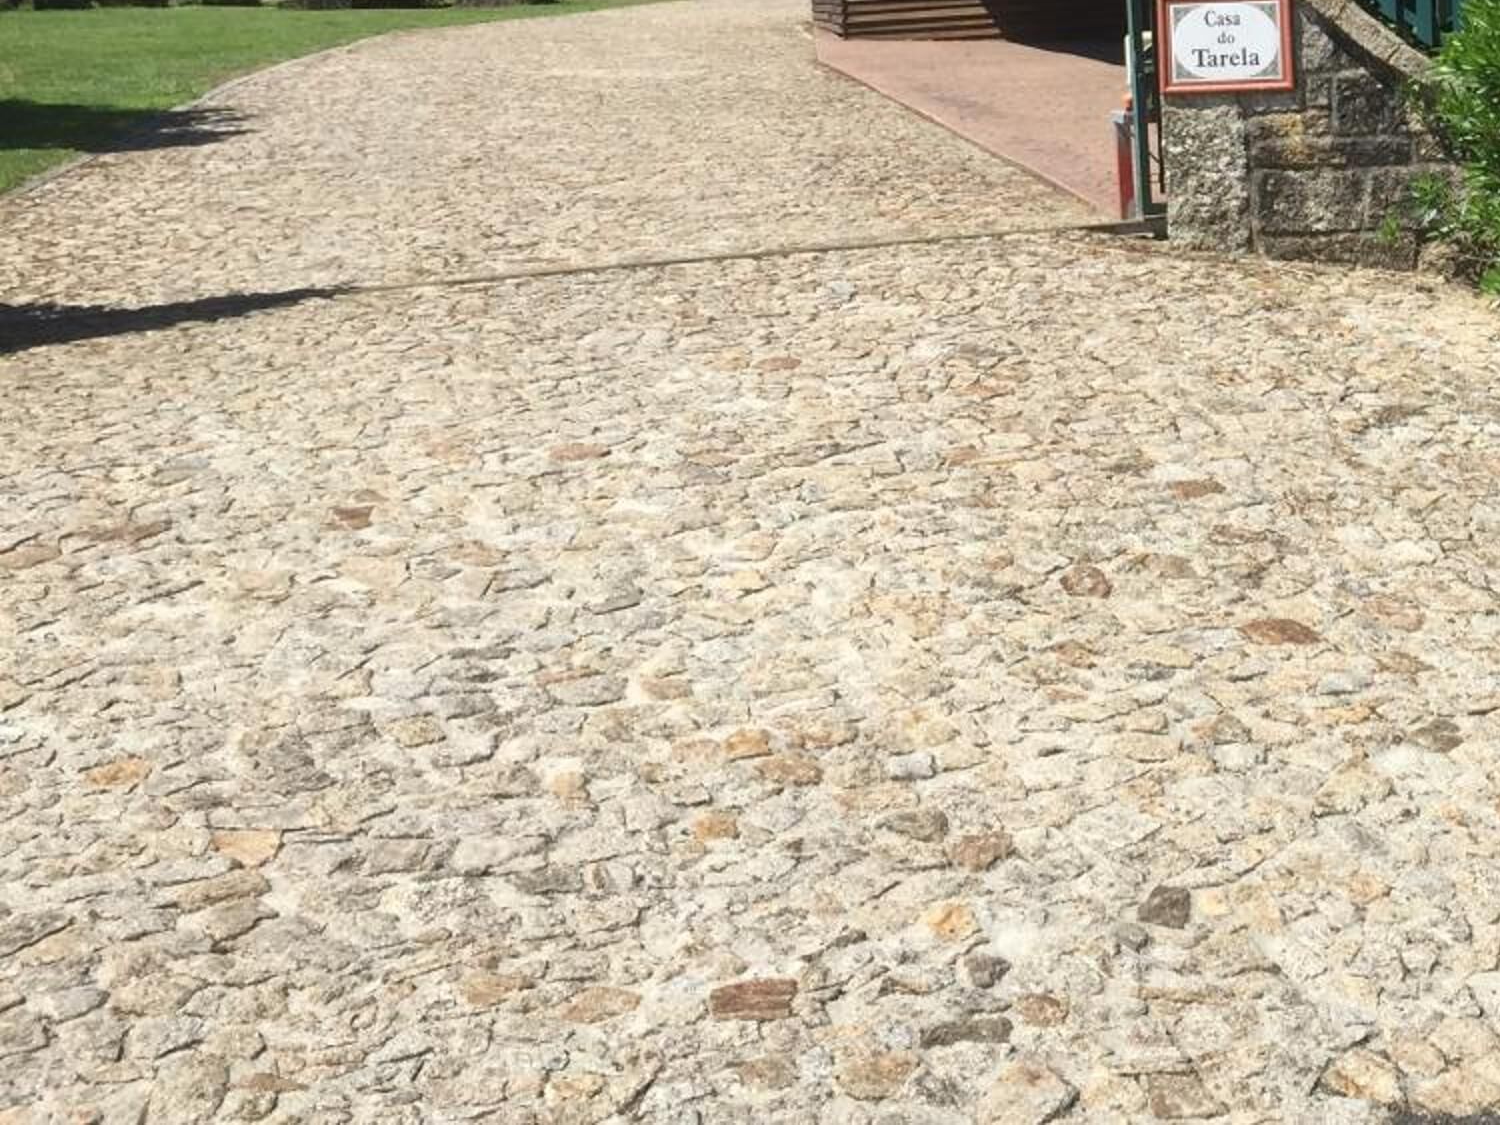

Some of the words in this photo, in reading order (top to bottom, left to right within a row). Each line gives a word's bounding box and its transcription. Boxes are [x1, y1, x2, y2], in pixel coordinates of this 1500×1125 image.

[1204, 10, 1241, 27] Casa
[1217, 31, 1235, 44] do
[1191, 47, 1260, 68] Tarela
